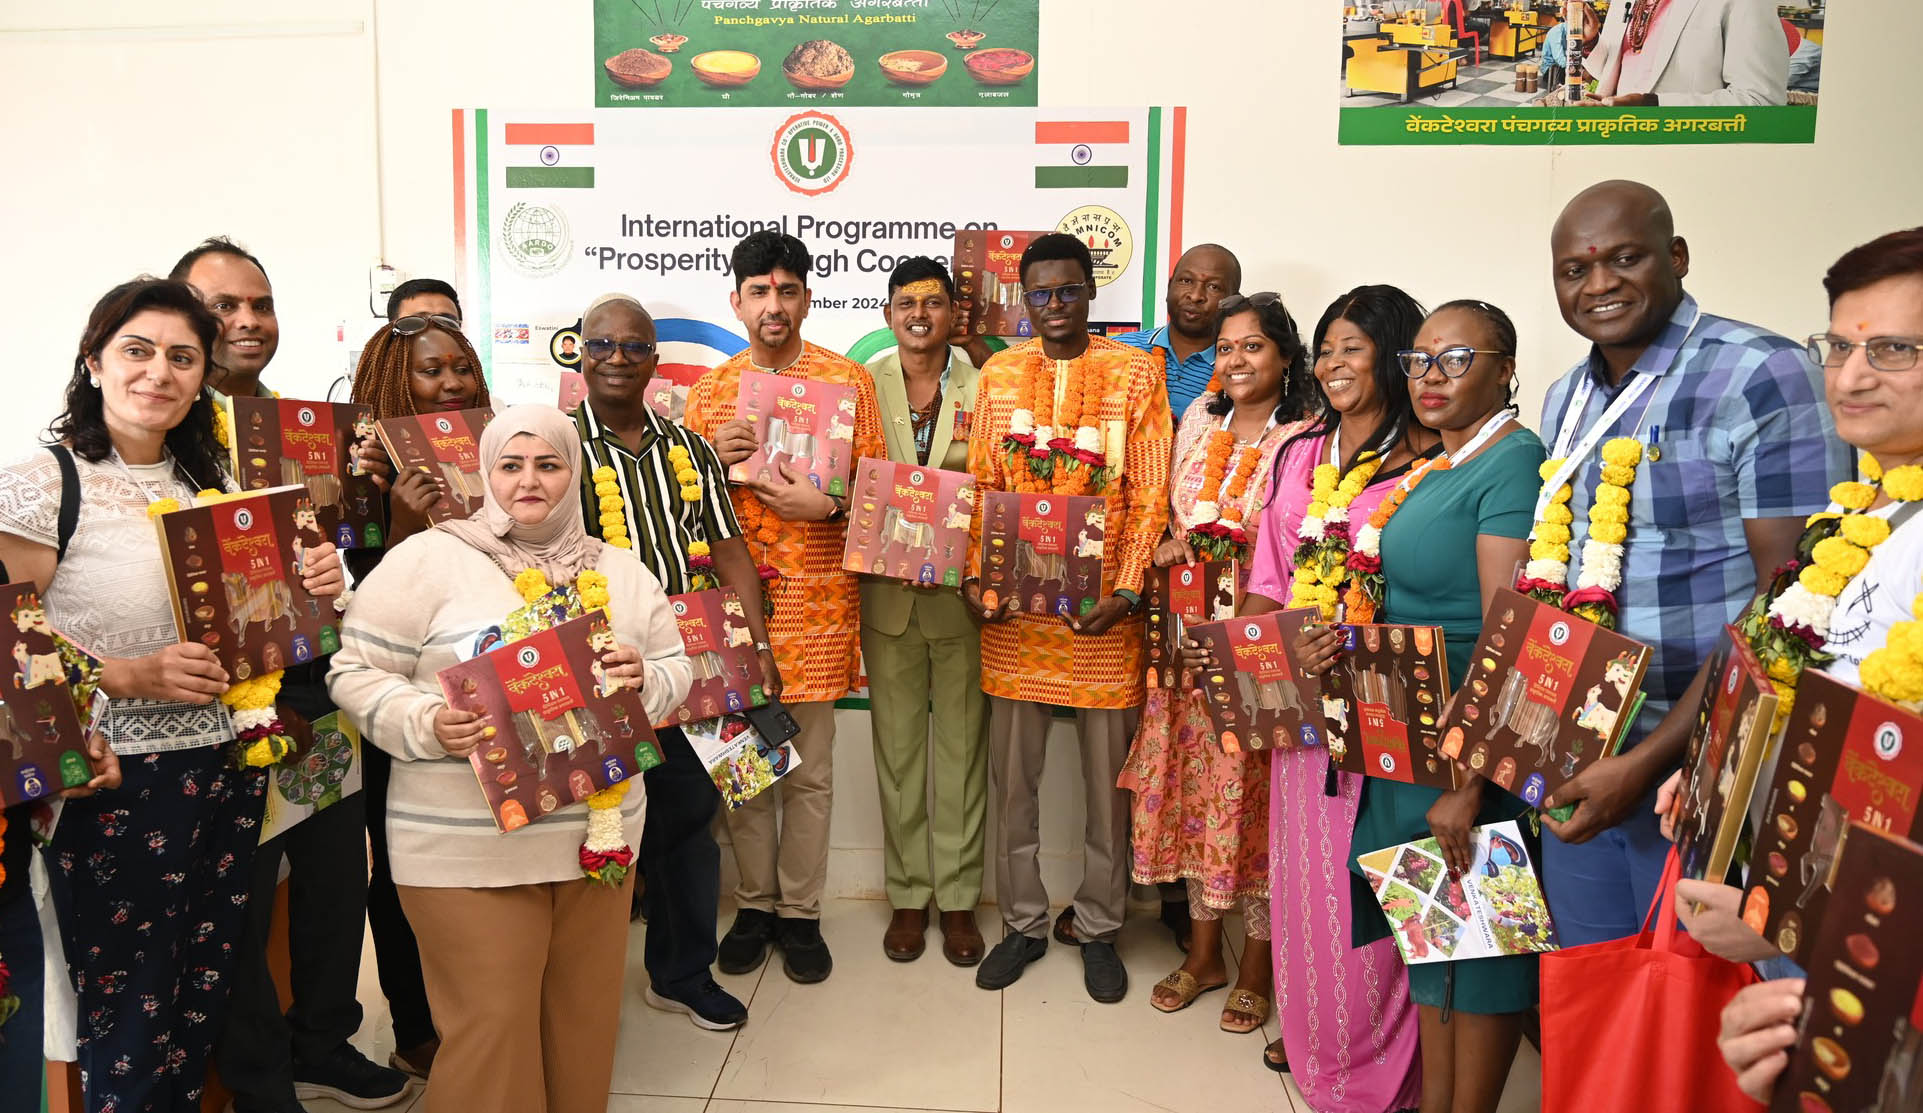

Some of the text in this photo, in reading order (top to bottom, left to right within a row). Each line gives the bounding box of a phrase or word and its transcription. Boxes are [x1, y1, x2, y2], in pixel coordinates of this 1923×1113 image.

[714, 14, 917, 26] Panchgavya Natural Agarbatti
[1406, 113, 1746, 138] वेंकटेश्वरा पंचगव्य प्राकृतिक अगरबत्ती
[622, 214, 788, 238] International
[798, 216, 956, 244] Programme
[852, 298, 887, 309] 2024
[308, 452, 326, 460] 5 IN 1
[250, 556, 270, 569] 5 IN 1
[1538, 674, 1559, 691] 5 IN 1
[542, 686, 565, 703] 5 IN 1
[1863, 806, 1892, 832] 5 IN 1
[1467, 880, 1494, 949] VENKATESHWARA
